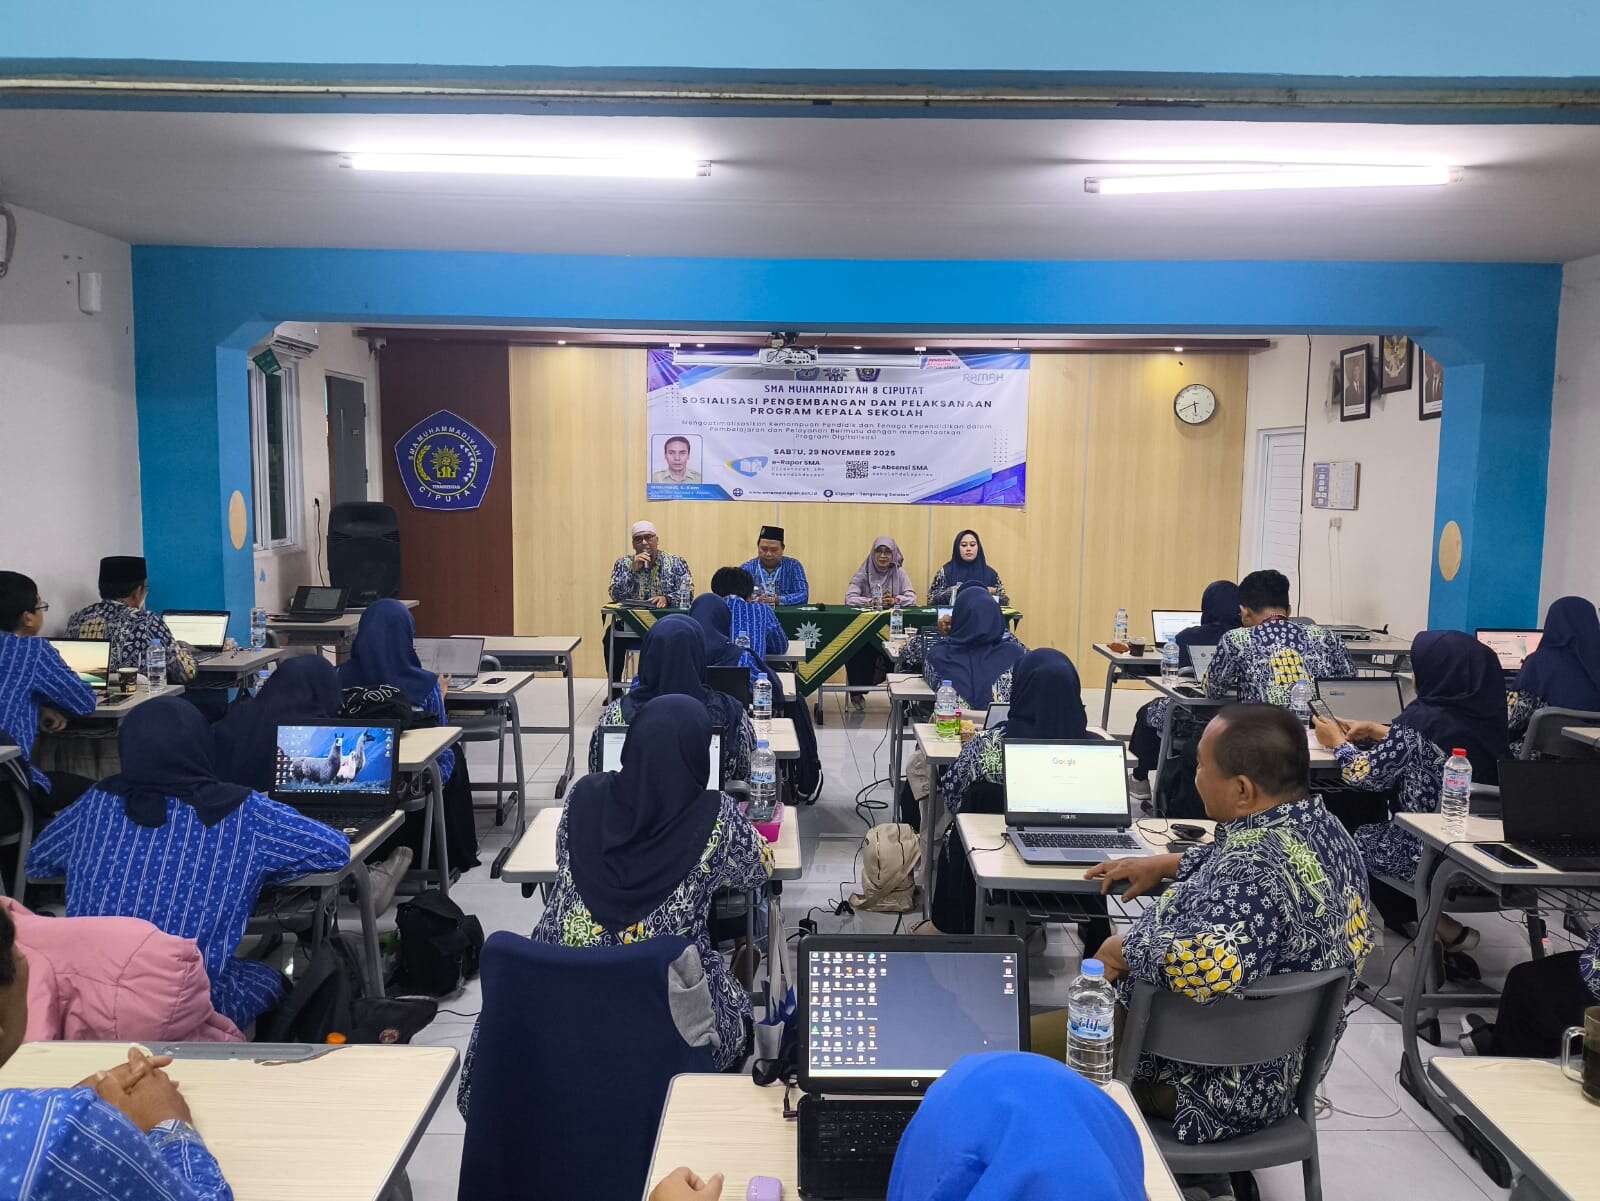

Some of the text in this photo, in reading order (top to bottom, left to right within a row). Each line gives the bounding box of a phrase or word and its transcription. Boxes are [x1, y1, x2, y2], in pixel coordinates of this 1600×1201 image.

[764, 384, 924, 395] SMA MUHAMMADIYAH 8 CIPUTAT
[682, 396, 992, 408] SOSIALISASI PENGEMBANGAN DAN PELAKSANAAN
[750, 407, 923, 417] PROGRAM KEPALA SEKOLAH
[416, 425, 481, 456] MUHAMMADIYAH
[419, 483, 478, 502] CIPUTAT
